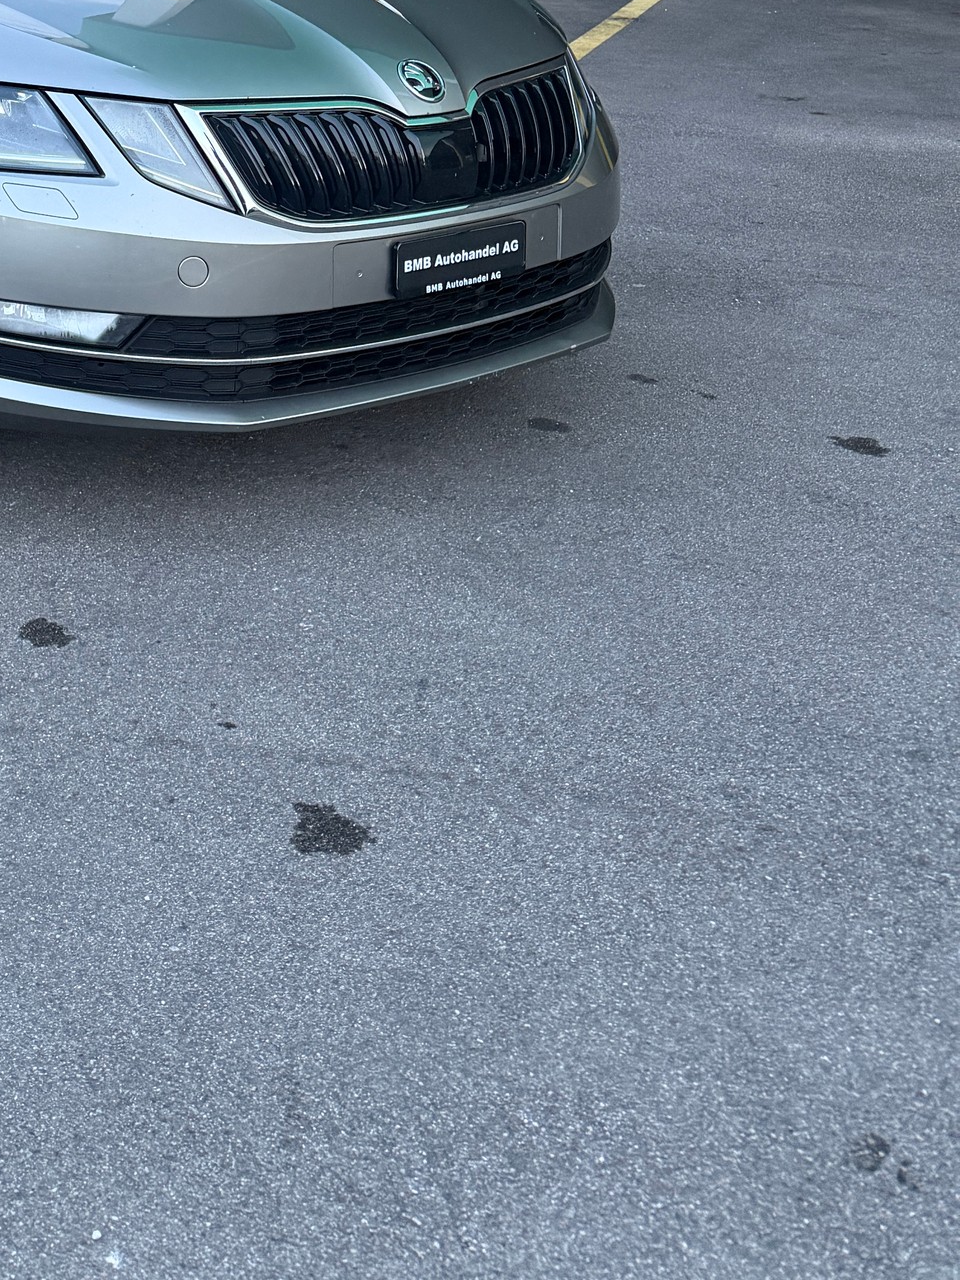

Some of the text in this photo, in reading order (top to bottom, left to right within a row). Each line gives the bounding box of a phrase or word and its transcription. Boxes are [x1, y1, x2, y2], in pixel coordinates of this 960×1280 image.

[404, 239, 519, 273] BMB Autohandel AG
[426, 271, 502, 294] BMB Autohandel AG
